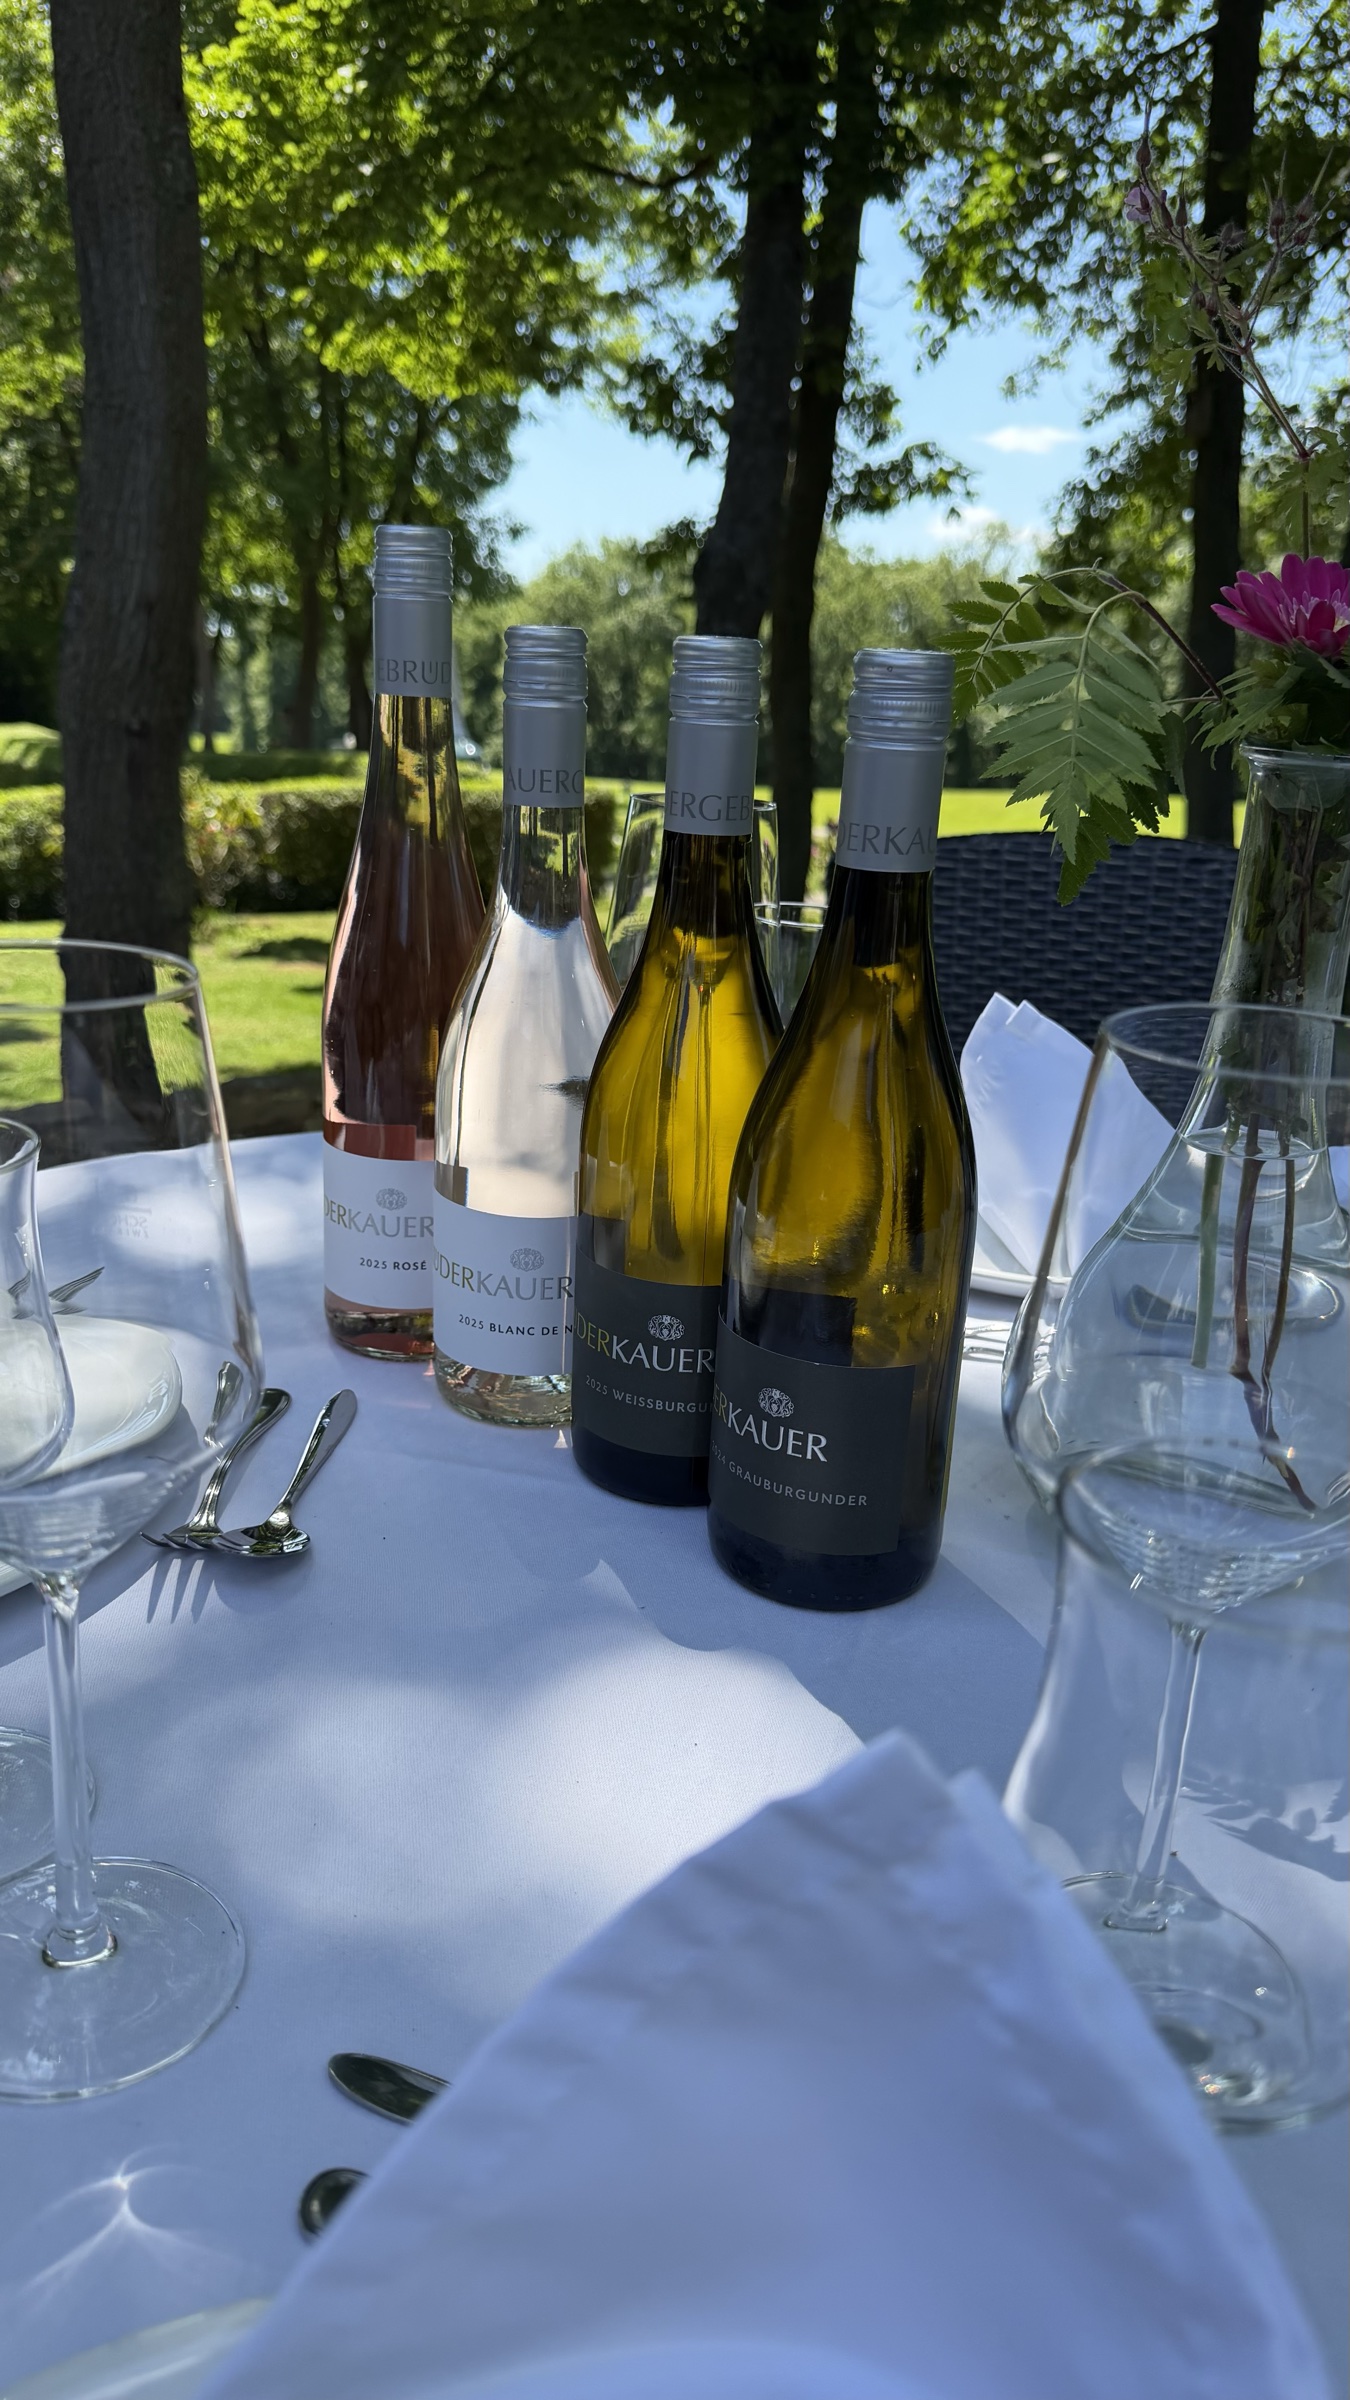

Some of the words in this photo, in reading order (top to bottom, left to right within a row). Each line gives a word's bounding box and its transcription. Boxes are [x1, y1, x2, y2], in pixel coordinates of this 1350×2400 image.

[359, 1257, 388, 1270] 2025
[392, 1260, 428, 1271] ROSÉ
[458, 1313, 484, 1330] 2025
[489, 1322, 535, 1336] BLANC
[541, 1325, 559, 1336] DE
[585, 1374, 608, 1395] 2025
[728, 1460, 868, 1506] GRAUBURGUNDER
